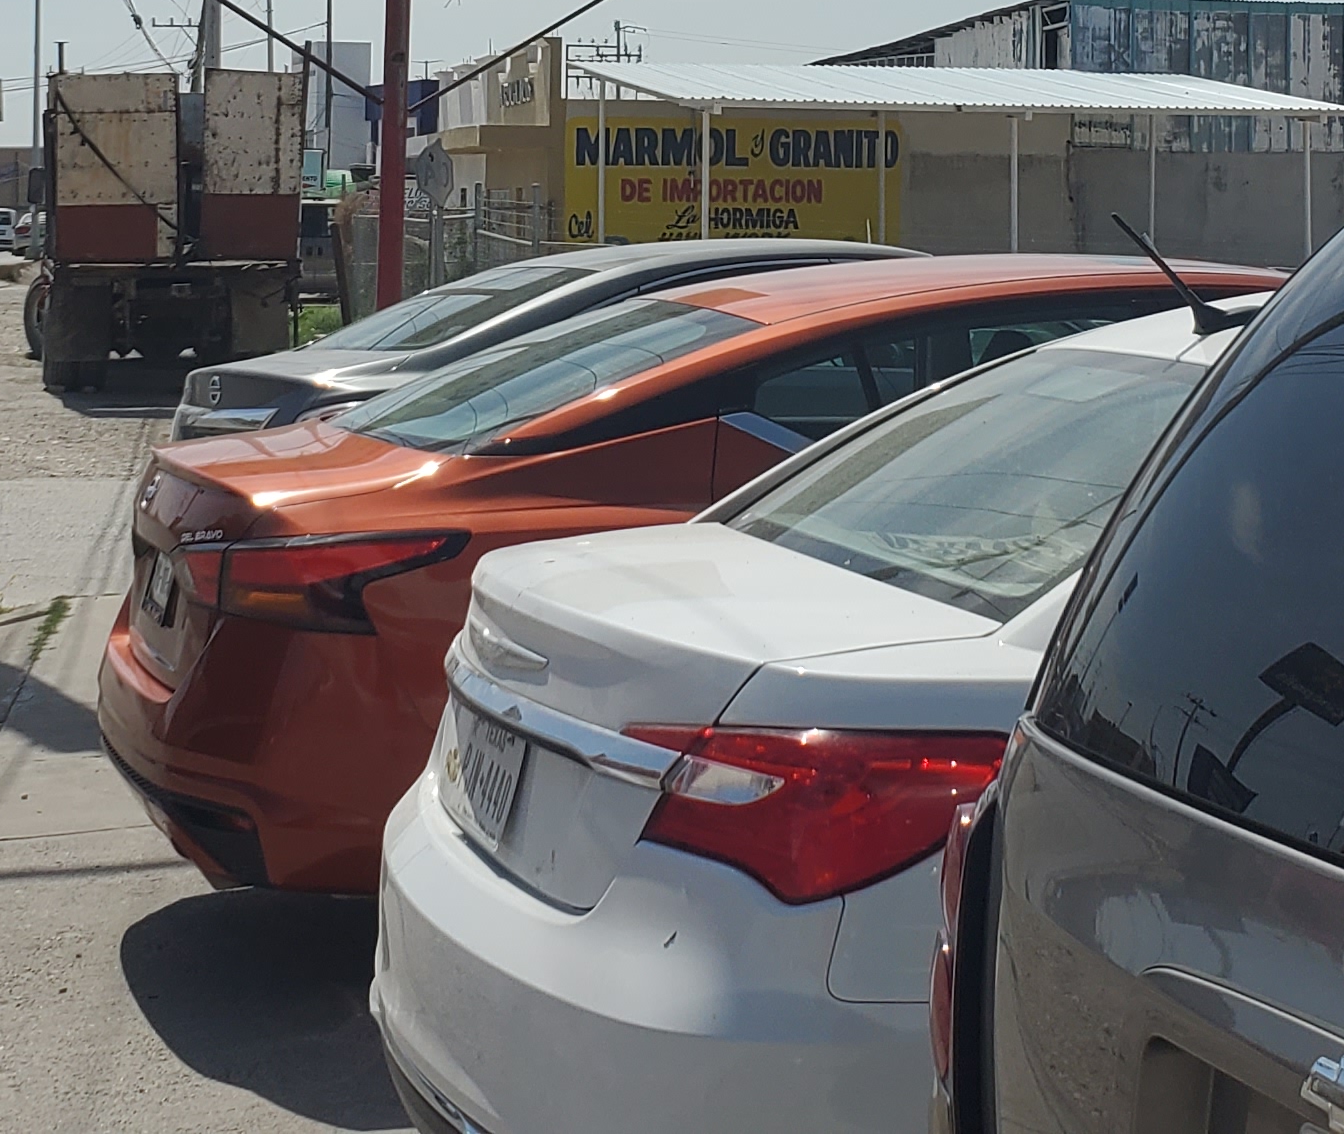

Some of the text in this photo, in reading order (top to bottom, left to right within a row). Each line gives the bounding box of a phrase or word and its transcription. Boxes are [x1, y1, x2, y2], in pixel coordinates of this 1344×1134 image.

[576, 127, 749, 167] MARMOL
[769, 128, 899, 169] GRANITO
[620, 178, 823, 204] DE IMPORTACION
[666, 205, 799, 230] La HORMIGA
[195, 530, 223, 540] BRAVO
